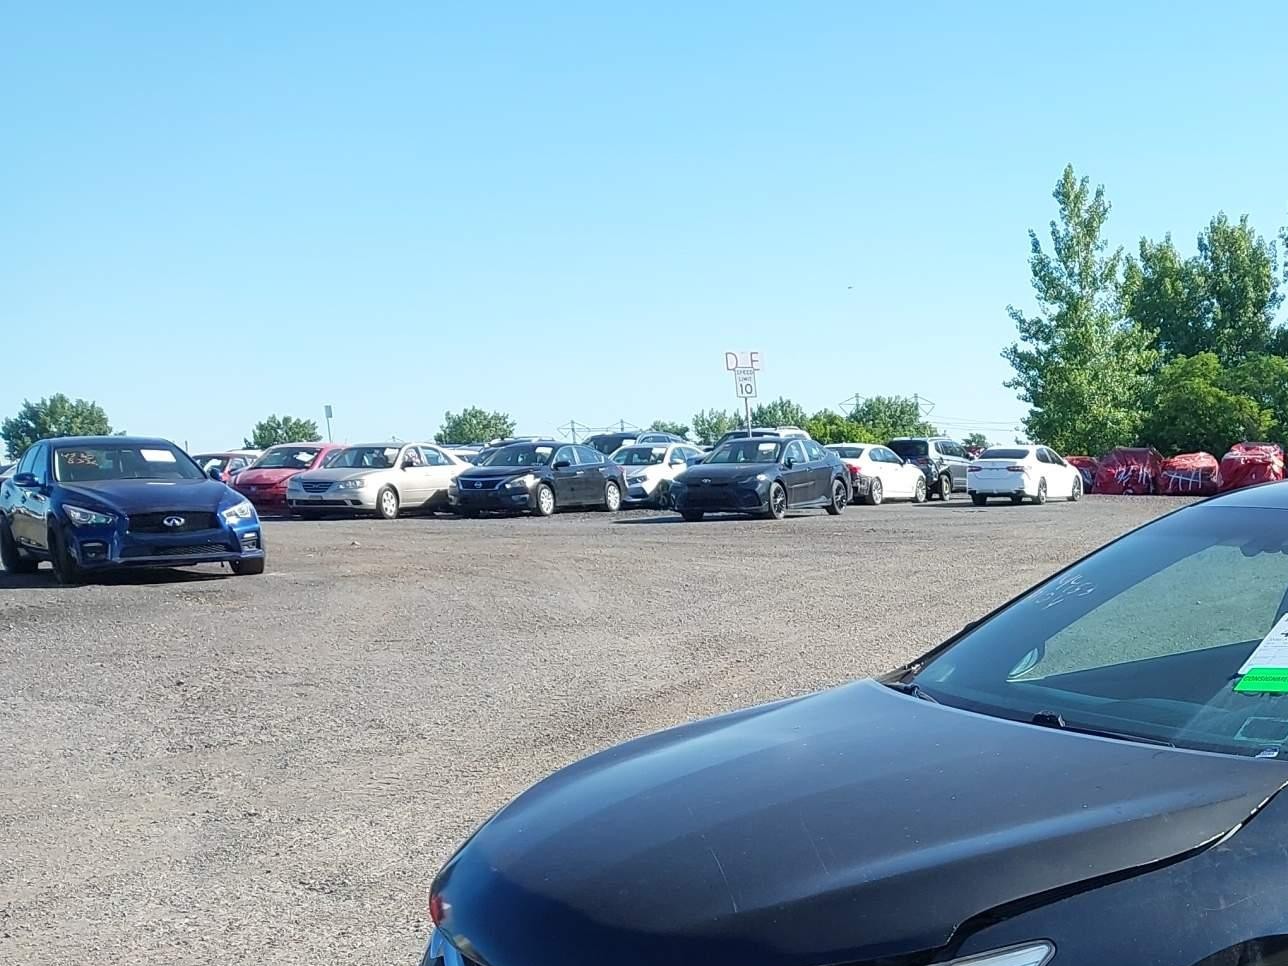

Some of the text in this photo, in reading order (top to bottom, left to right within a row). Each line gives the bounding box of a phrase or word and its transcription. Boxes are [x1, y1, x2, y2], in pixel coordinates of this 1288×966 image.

[725, 352, 760, 371] D E
[740, 383, 753, 395] 10
